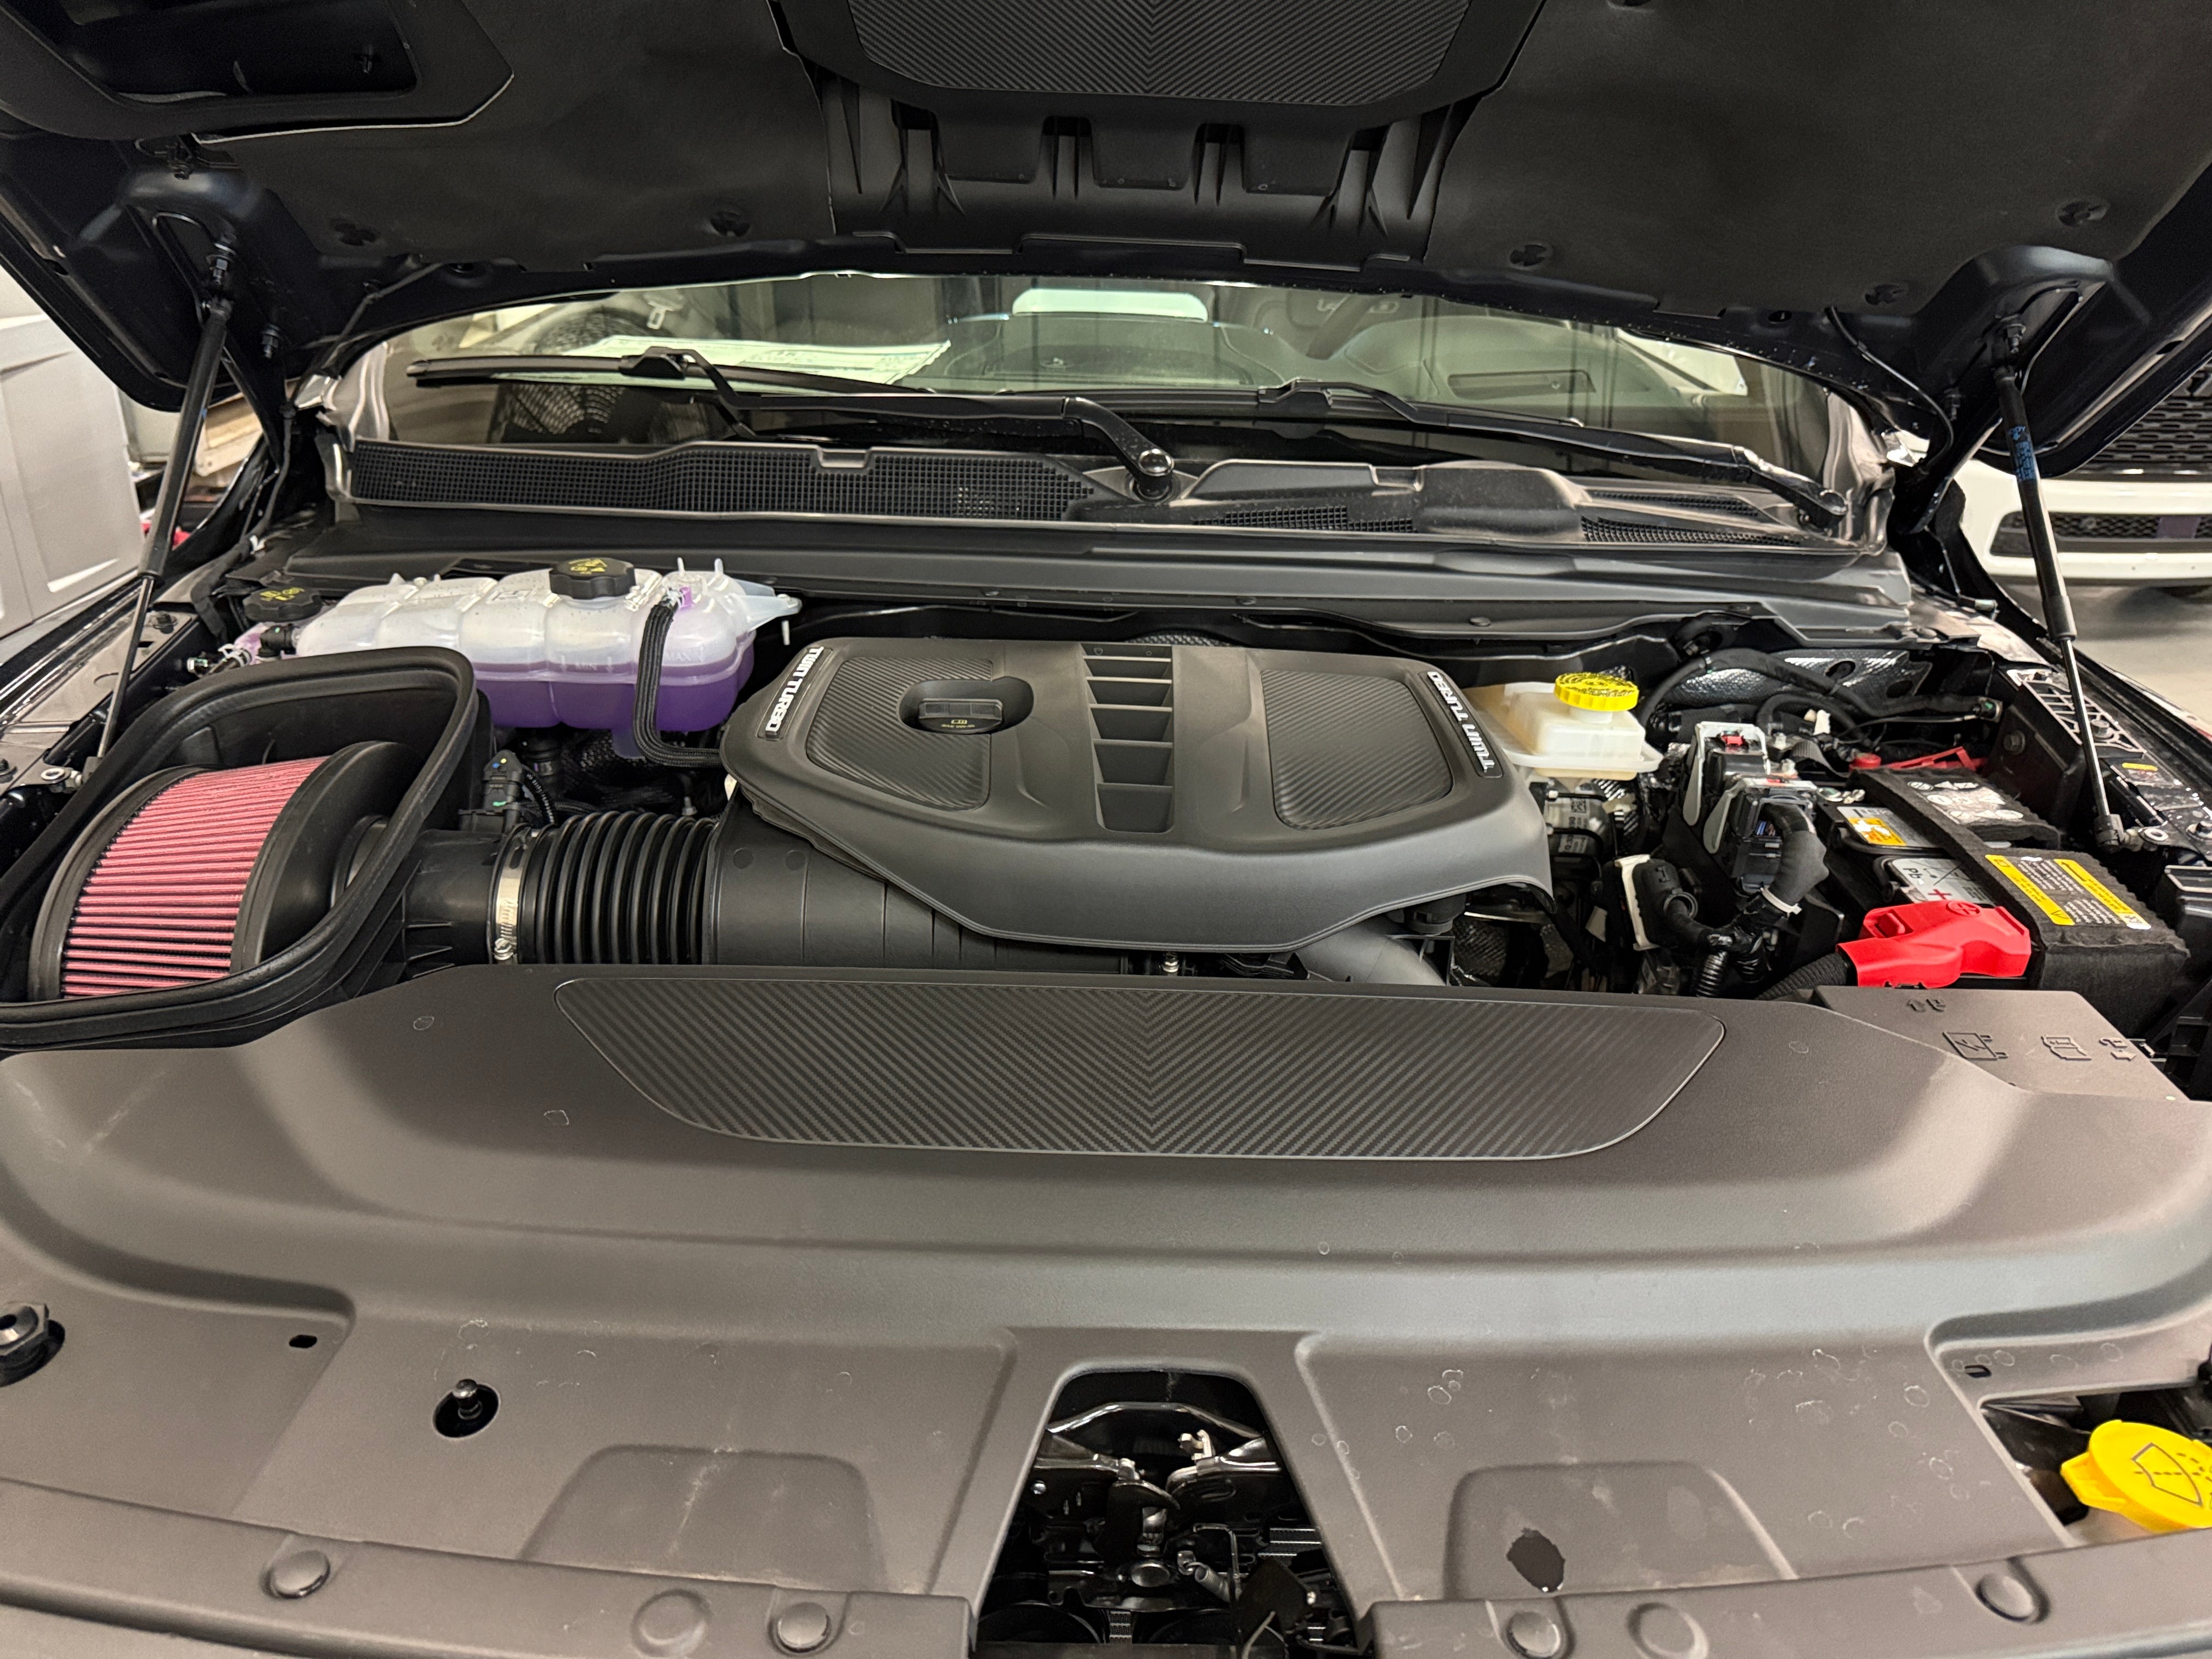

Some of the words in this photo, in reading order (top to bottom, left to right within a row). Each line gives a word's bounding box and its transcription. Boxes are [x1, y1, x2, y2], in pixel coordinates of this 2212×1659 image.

[793, 646, 824, 677] TWIN
[765, 678, 803, 732] TURBO
[1427, 672, 1469, 722] TURBO
[1462, 724, 1495, 770] TWIN
[1903, 868, 1922, 879] Pb
